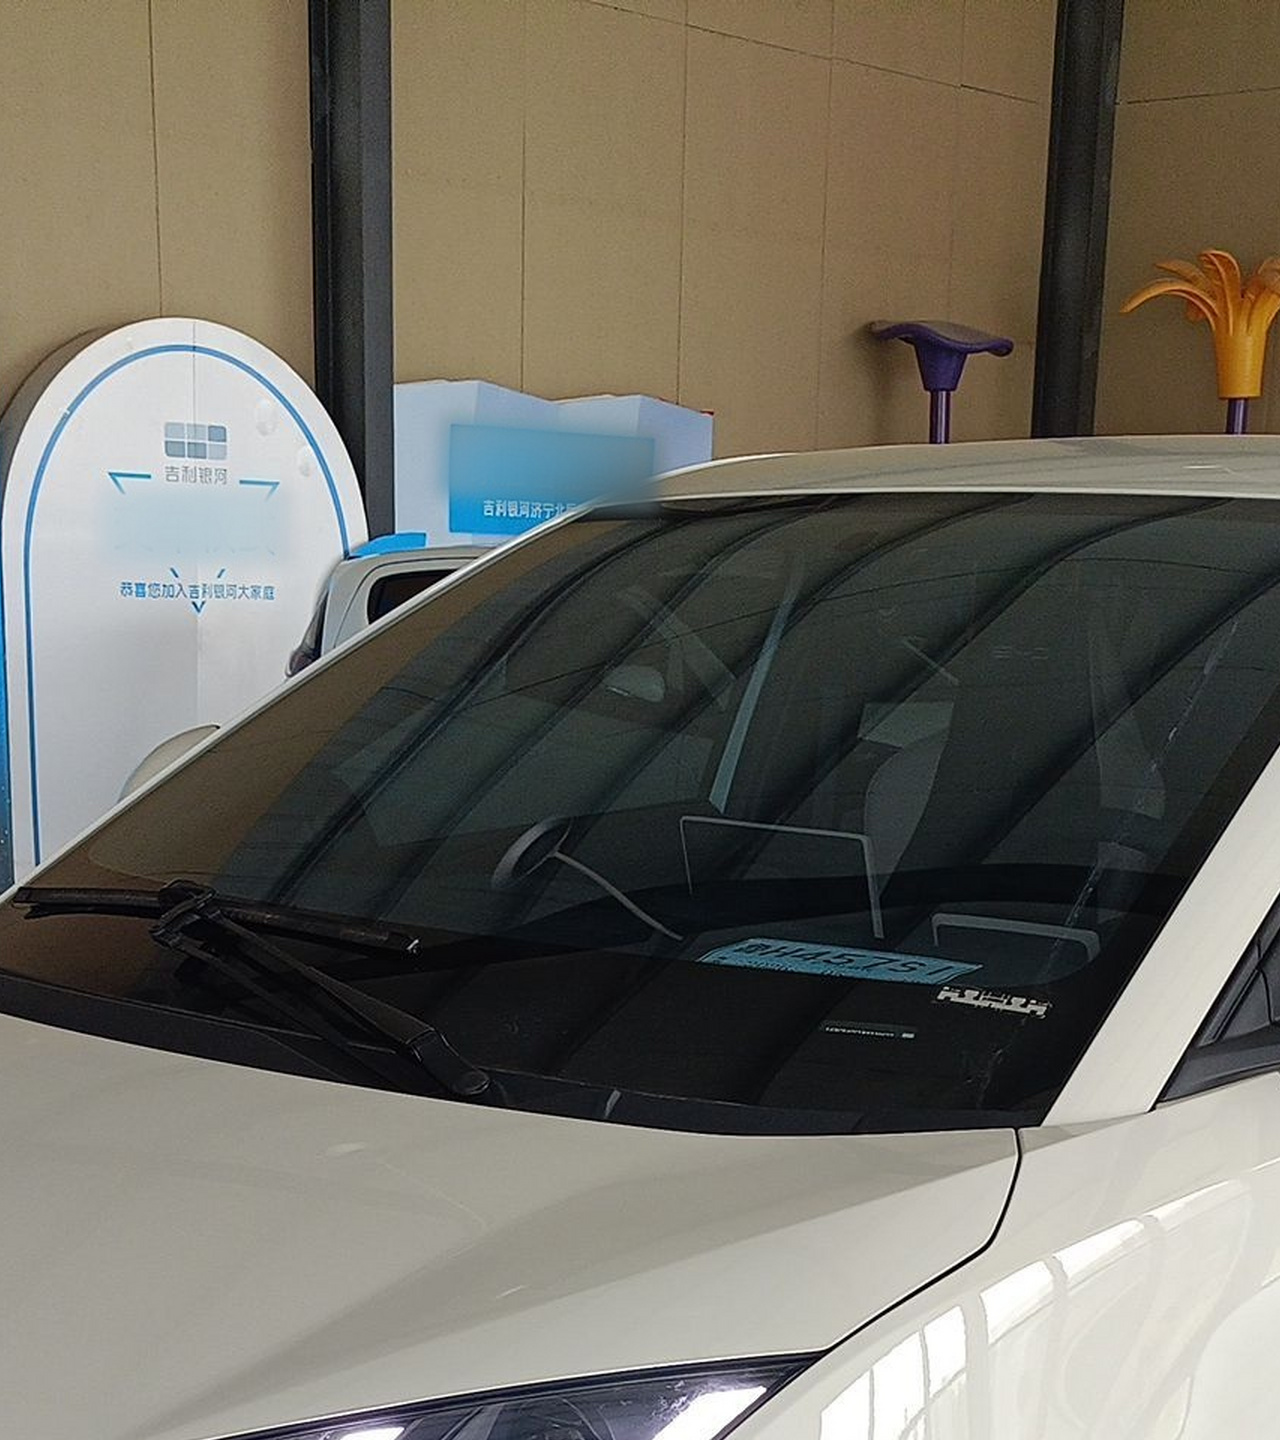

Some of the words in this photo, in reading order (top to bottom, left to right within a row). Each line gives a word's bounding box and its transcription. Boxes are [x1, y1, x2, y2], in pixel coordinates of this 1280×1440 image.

[165, 466, 228, 485] 吉利银河
[120, 582, 275, 600] 恭喜您加入吉利银河大家庭
